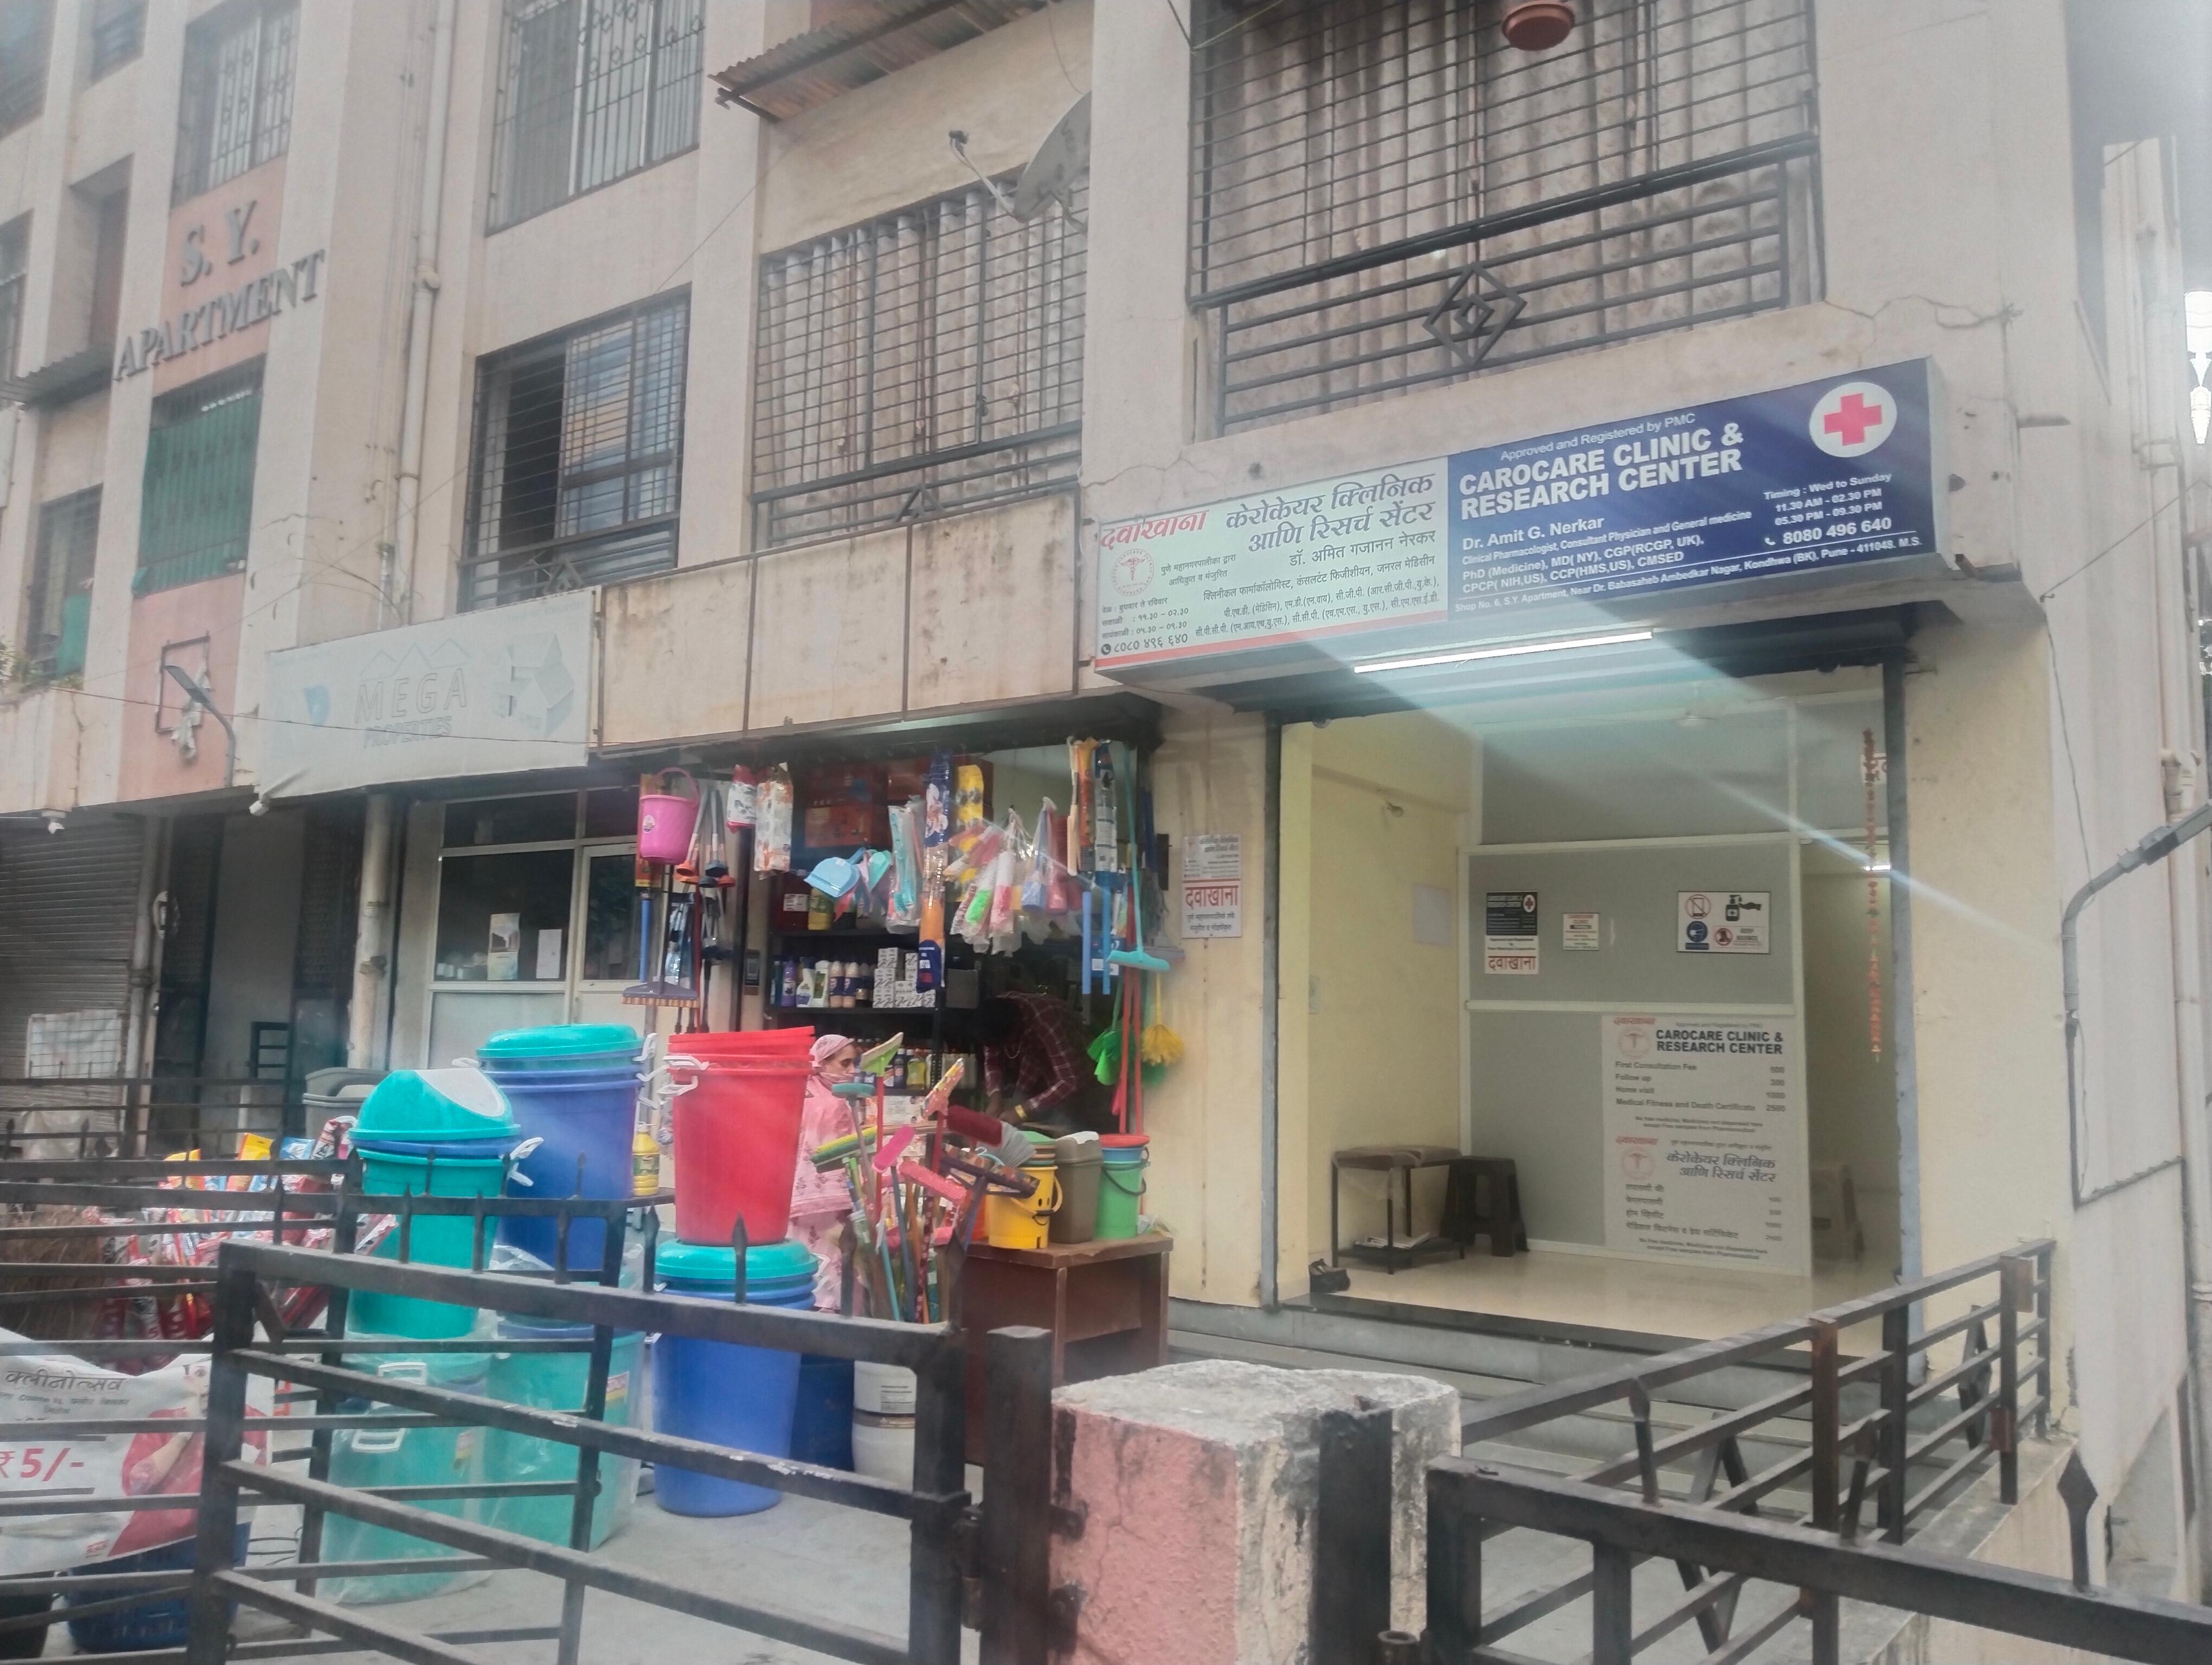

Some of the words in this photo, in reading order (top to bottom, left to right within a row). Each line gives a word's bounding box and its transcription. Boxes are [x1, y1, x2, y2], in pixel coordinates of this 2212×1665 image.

[113, 248, 326, 382] APARTMENT
[1500, 442, 1554, 461] Approved
[1556, 437, 1579, 450] and
[1581, 425, 1644, 445] Registered
[1646, 420, 1662, 433] by
[1664, 413, 1696, 428] PMC
[1459, 449, 1605, 496] CAROCARE
[1613, 428, 1712, 467] CLINIC
[1721, 422, 1744, 446] &
[1461, 472, 1610, 520] RESEARCH
[1618, 449, 1743, 492] CENTER
[1763, 488, 1801, 500] Timing
[1809, 482, 1834, 492] Wed
[1835, 480, 1847, 488] to
[1850, 473, 1892, 487] Sunday
[1775, 501, 1803, 512] 11.30
[1804, 498, 1823, 508] AM
[1831, 492, 1862, 503] 02.30
[1863, 488, 1883, 499] PM
[1226, 496, 1325, 529] केरोकेयर
[1331, 473, 1435, 510] क्लिनिक
[1775, 514, 1804, 526] 05.30
[1805, 511, 1824, 521] PM
[1832, 505, 1862, 517] 09.30
[1864, 502, 1883, 511] PM
[1100, 510, 1209, 550] दवाखाना
[1249, 521, 1304, 552] आणि
[1310, 506, 1373, 541] रिसर्च
[1380, 500, 1435, 528] सेंटर
[1462, 553, 1493, 565] Clinical
[1493, 543, 1559, 560] Pharmacologist,
[1560, 534, 1607, 549] Consultant
[1608, 528, 1652, 543] Physician
[1653, 524, 1670, 534] and
[1671, 517, 1707, 531] General
[1709, 511, 1752, 525] medicine
[1463, 538, 1484, 551] Dr.
[1487, 529, 1524, 547] Amit
[1528, 526, 1545, 540] G.
[1550, 518, 1605, 536] Nerkar
[1783, 528, 1823, 545] 8080
[1826, 522, 1857, 537] 496
[1861, 517, 1892, 533] 640
[1289, 549, 1306, 566] डॉ.
[1312, 544, 1345, 563] अमित
[1350, 537, 1394, 555] गजानन
[1399, 530, 1436, 549] नेरकर
[1637, 551, 1684, 567] CMSED
[1161, 564, 1171, 576] पुणे
[1223, 554, 1236, 564] द्वारा
[1203, 587, 1237, 601] क्लिनीकल
[1377, 561, 1402, 572] जनरल
[1404, 553, 1435, 568] मेडिसीन
[1455, 602, 1476, 612] Shop
[1478, 601, 1492, 609] No.
[1521, 589, 1569, 604] Apartment,
[1570, 586, 1592, 596] Near
[1593, 583, 1606, 593] Dr.
[1608, 575, 1659, 590] Babasaheb
[1661, 569, 1709, 583] Ambedkar
[1710, 563, 1743, 575] Nagar,
[1744, 555, 1791, 570] Kondhwa
[1821, 547, 1849, 558] Pune
[1899, 536, 1922, 548] M.S.
[1463, 569, 1486, 581] PhD
[1140, 600, 1145, 608] ते
[1147, 597, 1168, 606] रविवार
[1114, 640, 1139, 653] ८०८०
[1143, 636, 1163, 648] ४९६
[1168, 634, 1188, 646] ६४०
[355, 668, 467, 723] MEGA
[363, 716, 452, 748] PROPERTIES
[1185, 885, 1239, 909] दवाखाना
[1488, 955, 1537, 971] दवाखाना
[1656, 1030, 1724, 1041] CAROCARE
[1728, 1031, 1770, 1042] CLINIC
[1774, 1032, 1784, 1042] &
[1657, 1041, 1725, 1053] RESEARCH
[1729, 1043, 1783, 1055] CENTER
